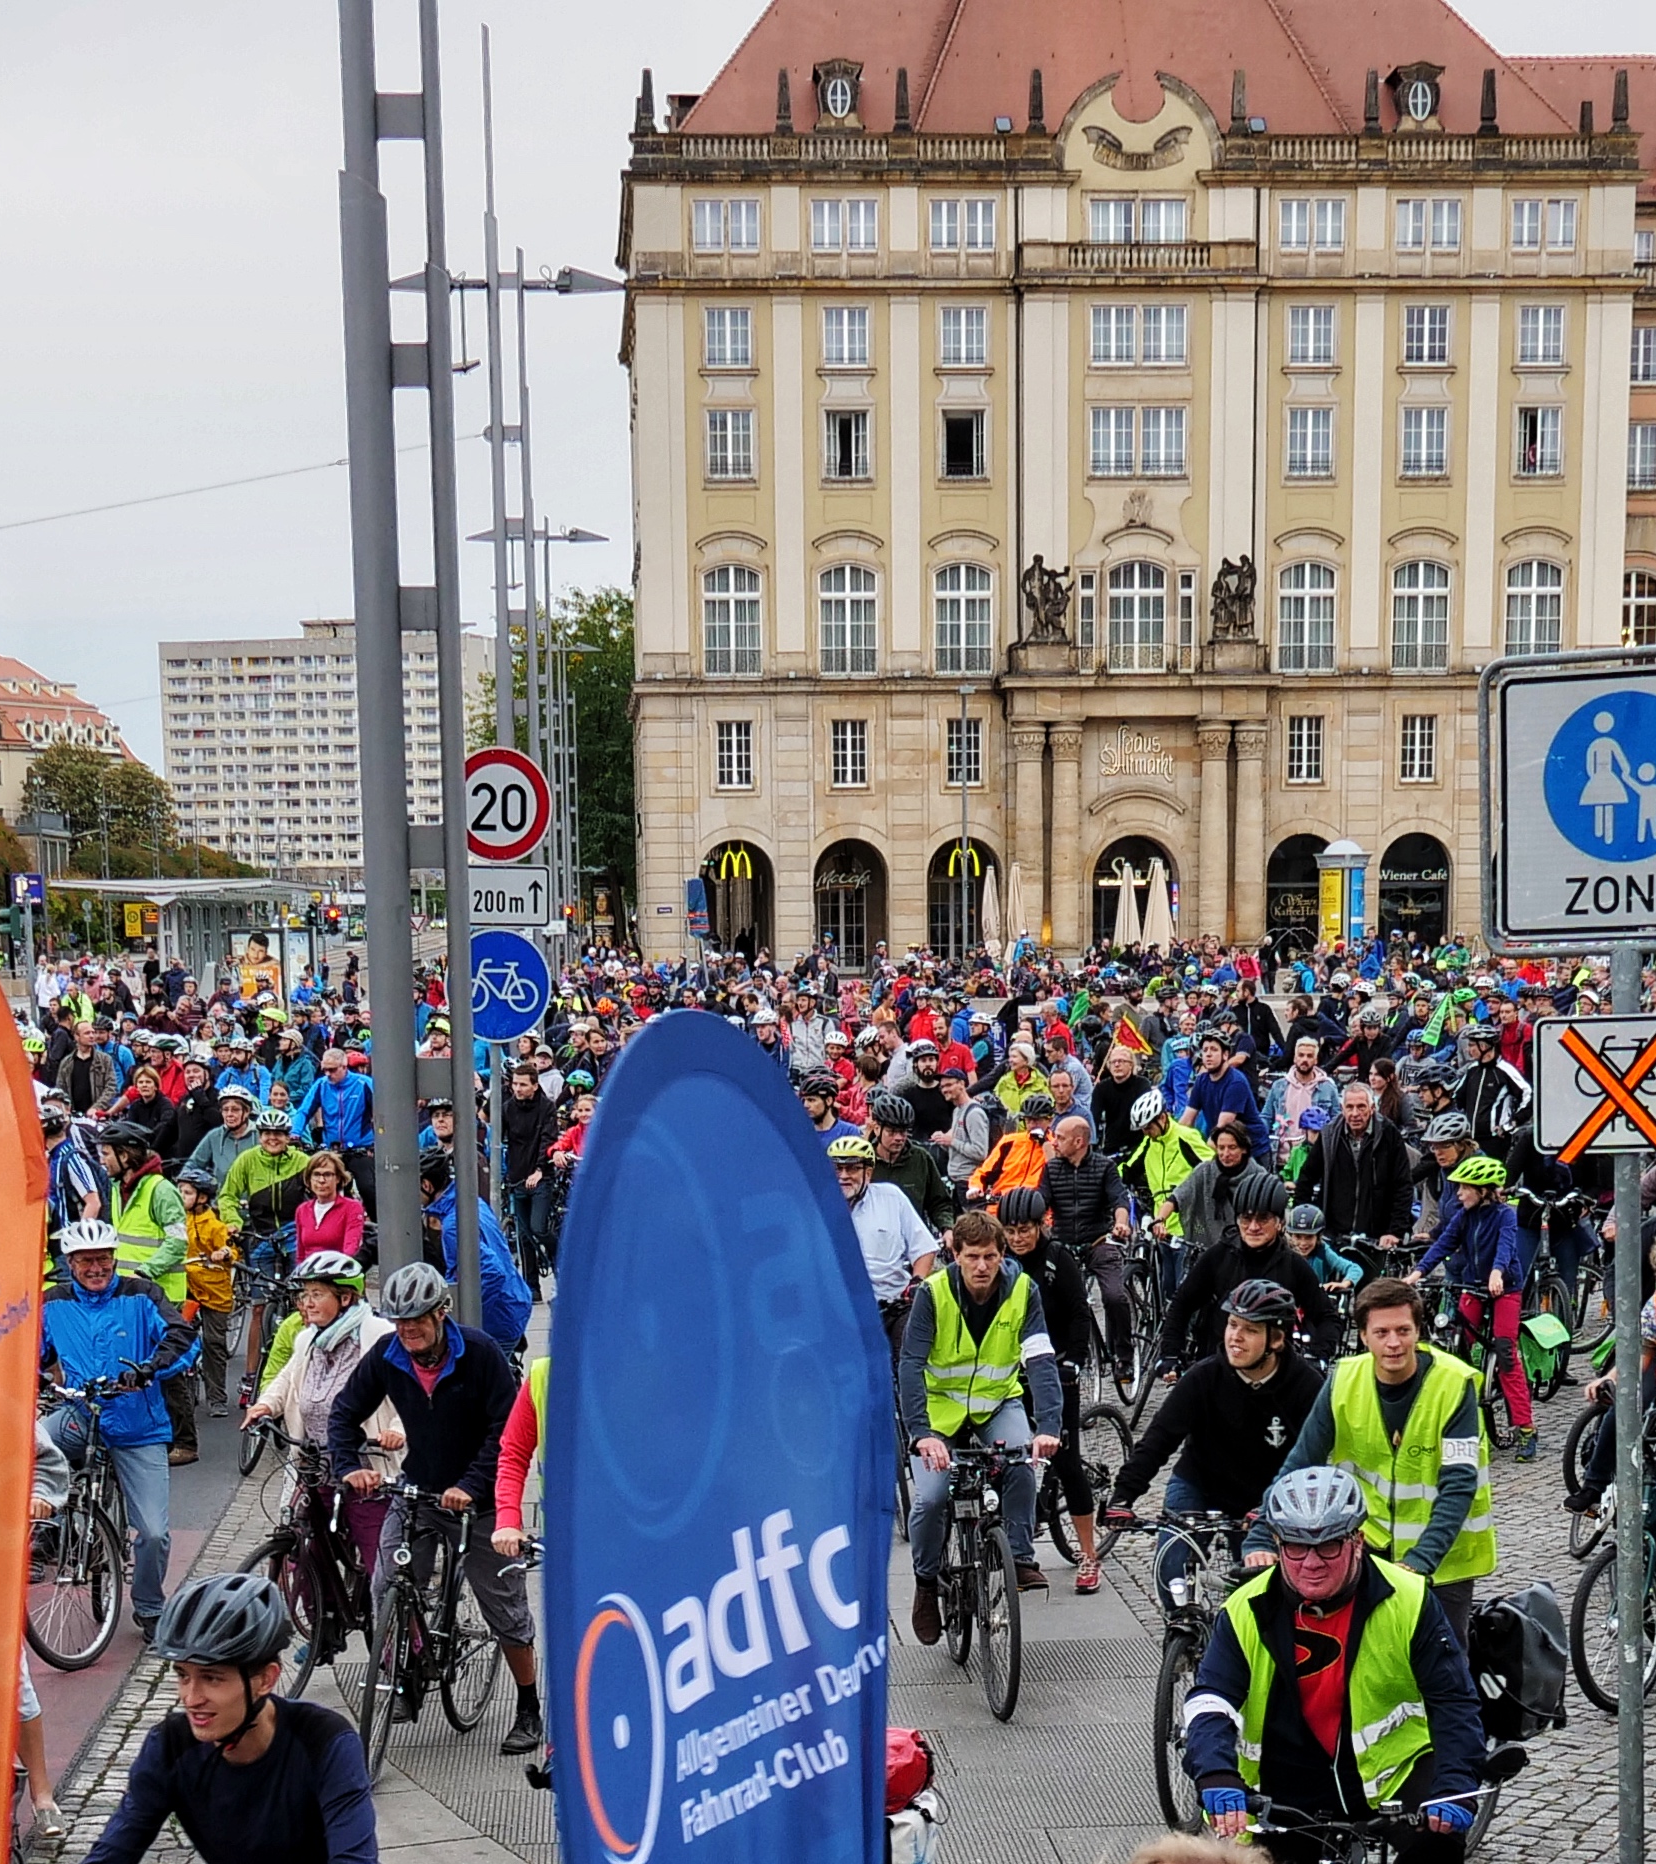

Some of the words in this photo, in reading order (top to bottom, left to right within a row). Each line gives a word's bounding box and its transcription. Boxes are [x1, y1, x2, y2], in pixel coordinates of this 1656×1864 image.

[471, 782, 528, 833] 20
[1421, 867, 1448, 882] Café
[662, 1508, 860, 1715] adfc
[675, 1683, 814, 1784] Allgemeiner
[680, 1726, 850, 1845] Fahrrad-Club
